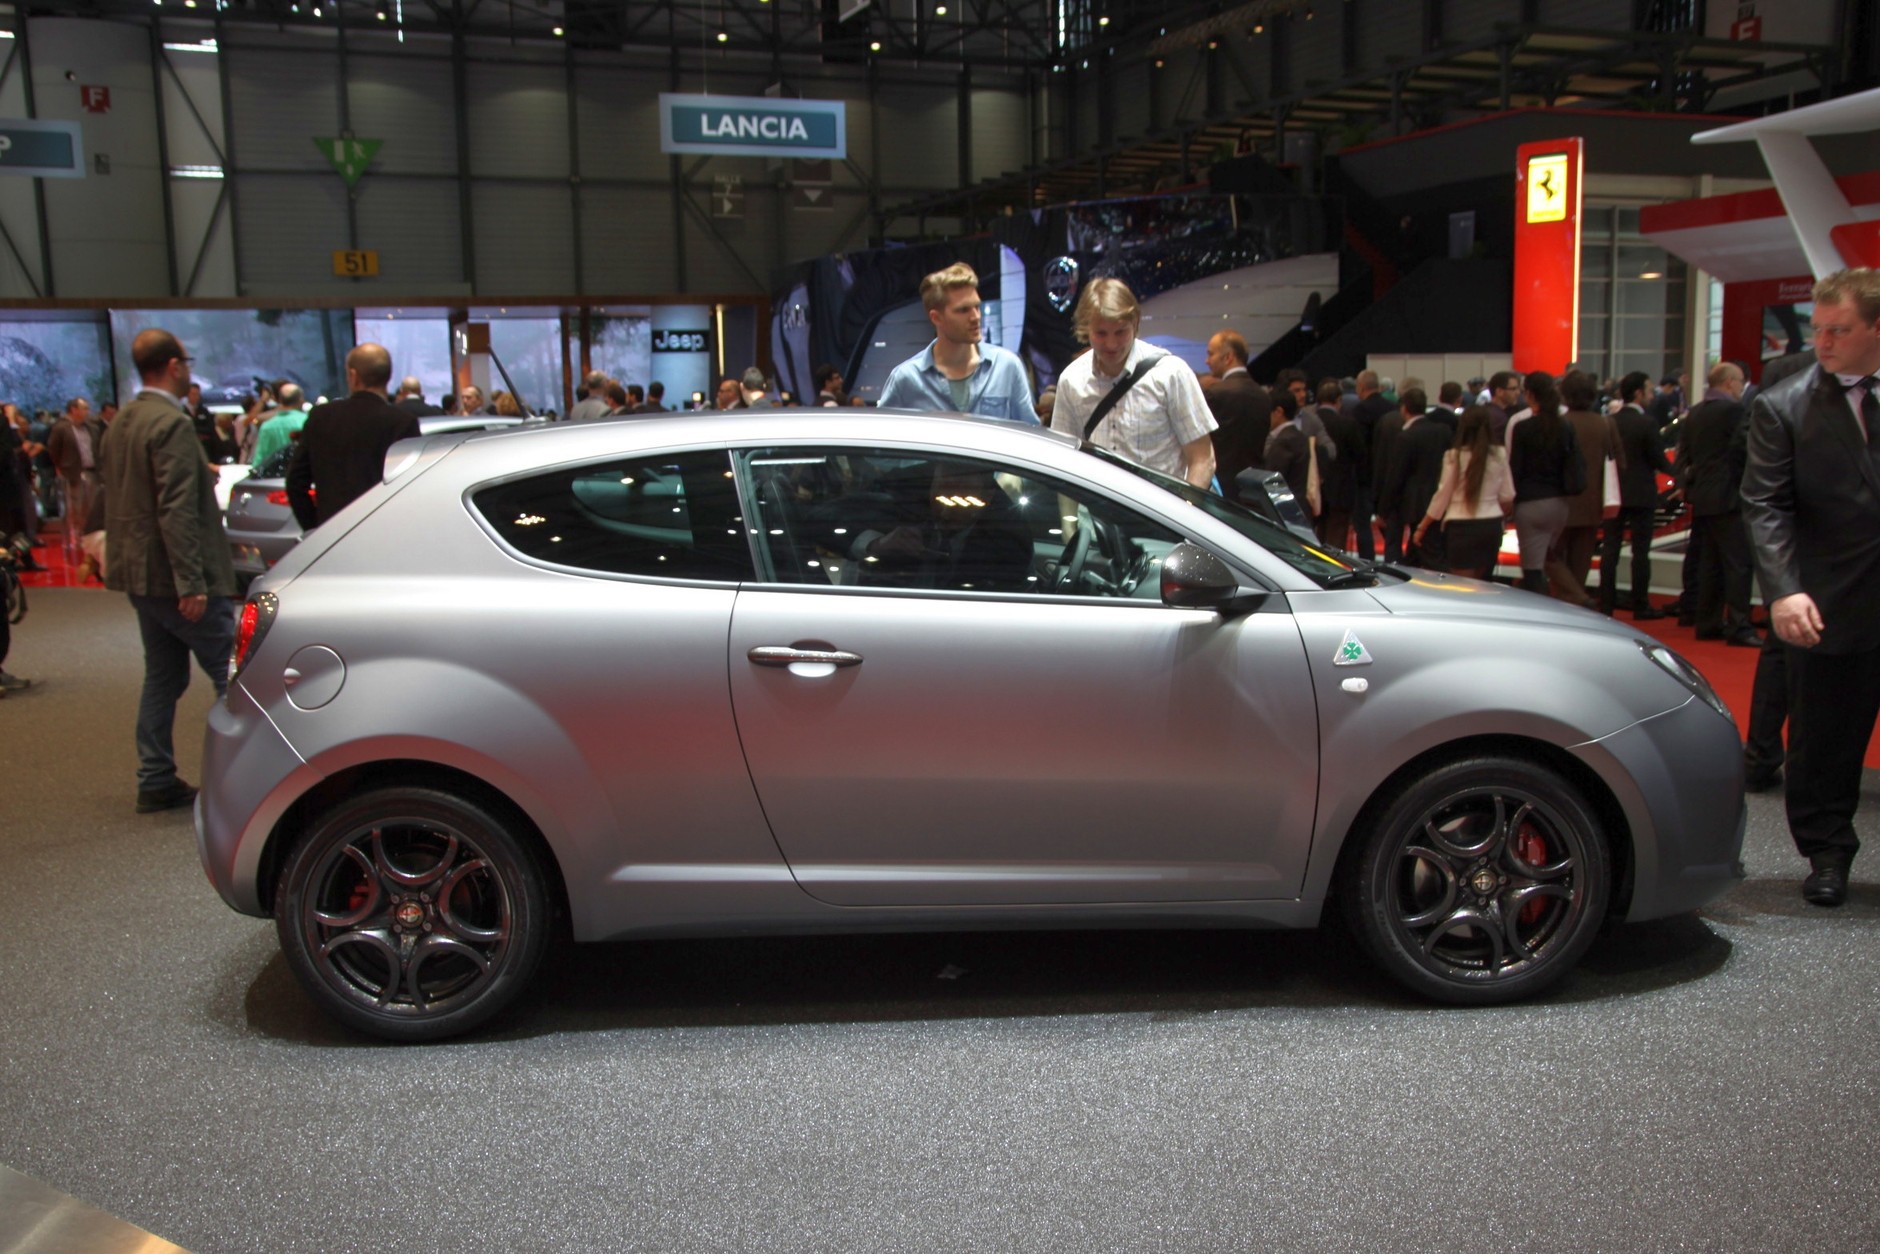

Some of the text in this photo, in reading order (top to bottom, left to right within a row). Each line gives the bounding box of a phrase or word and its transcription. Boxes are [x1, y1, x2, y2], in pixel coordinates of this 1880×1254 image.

[90, 88, 103, 106] F
[701, 114, 808, 140] LANCIA
[345, 252, 367, 272] 51
[655, 330, 704, 351] Jeep
